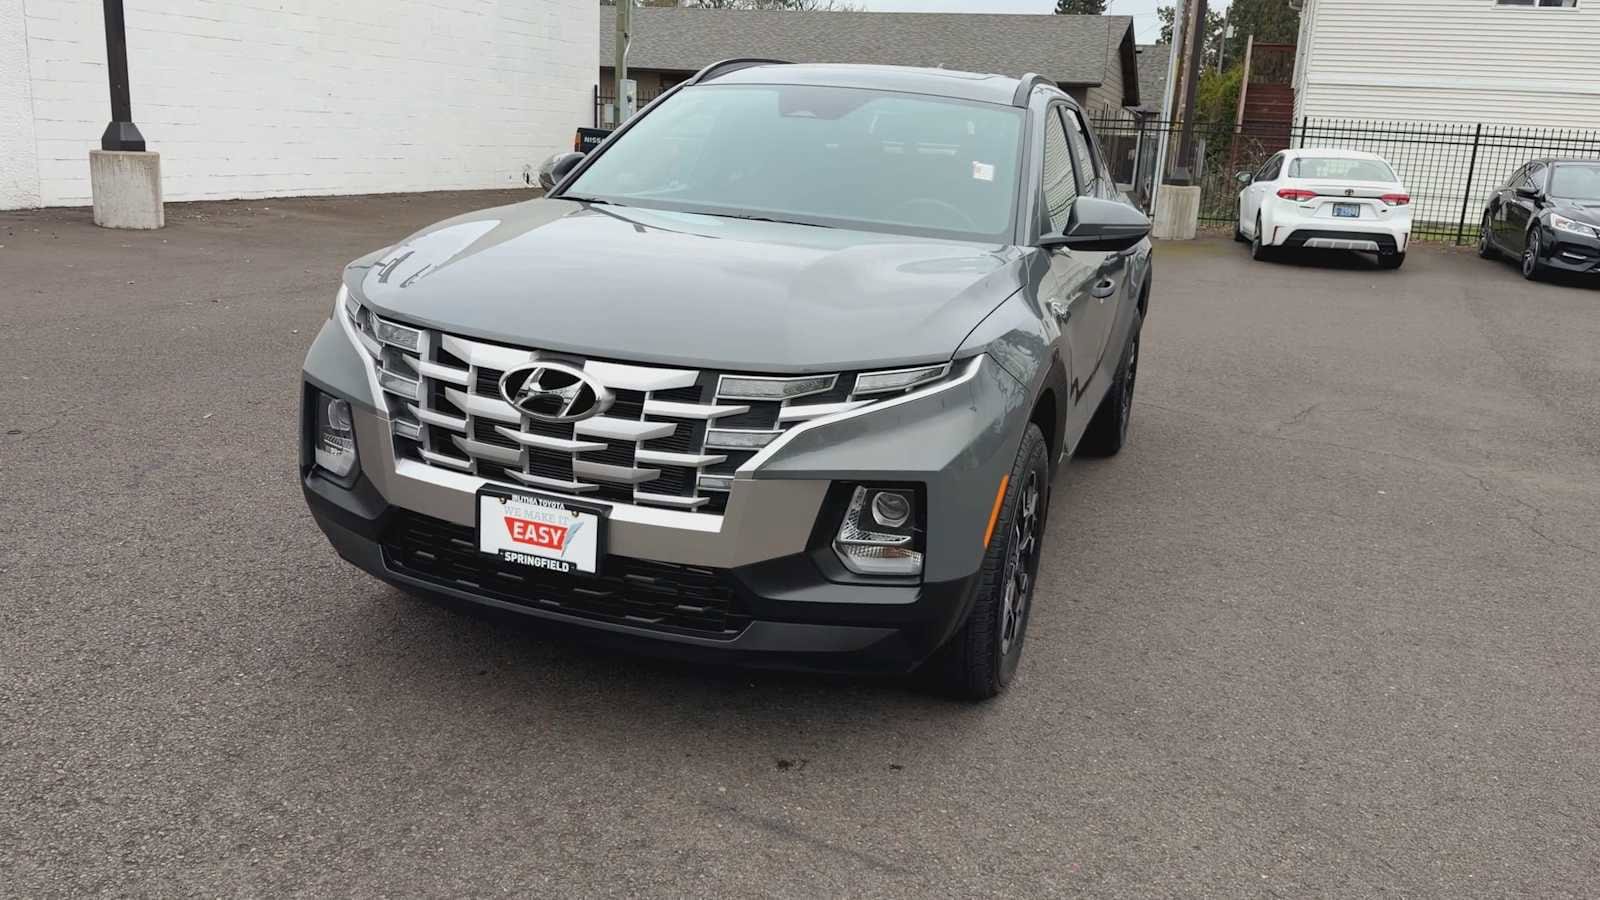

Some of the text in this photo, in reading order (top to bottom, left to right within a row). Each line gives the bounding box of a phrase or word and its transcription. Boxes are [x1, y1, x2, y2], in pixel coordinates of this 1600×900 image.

[539, 498, 565, 510] TOYOTA
[505, 506, 520, 517] WE
[527, 509, 557, 523] MAKE
[513, 521, 562, 545] EASY
[504, 551, 569, 572] SPRINGFIELD
